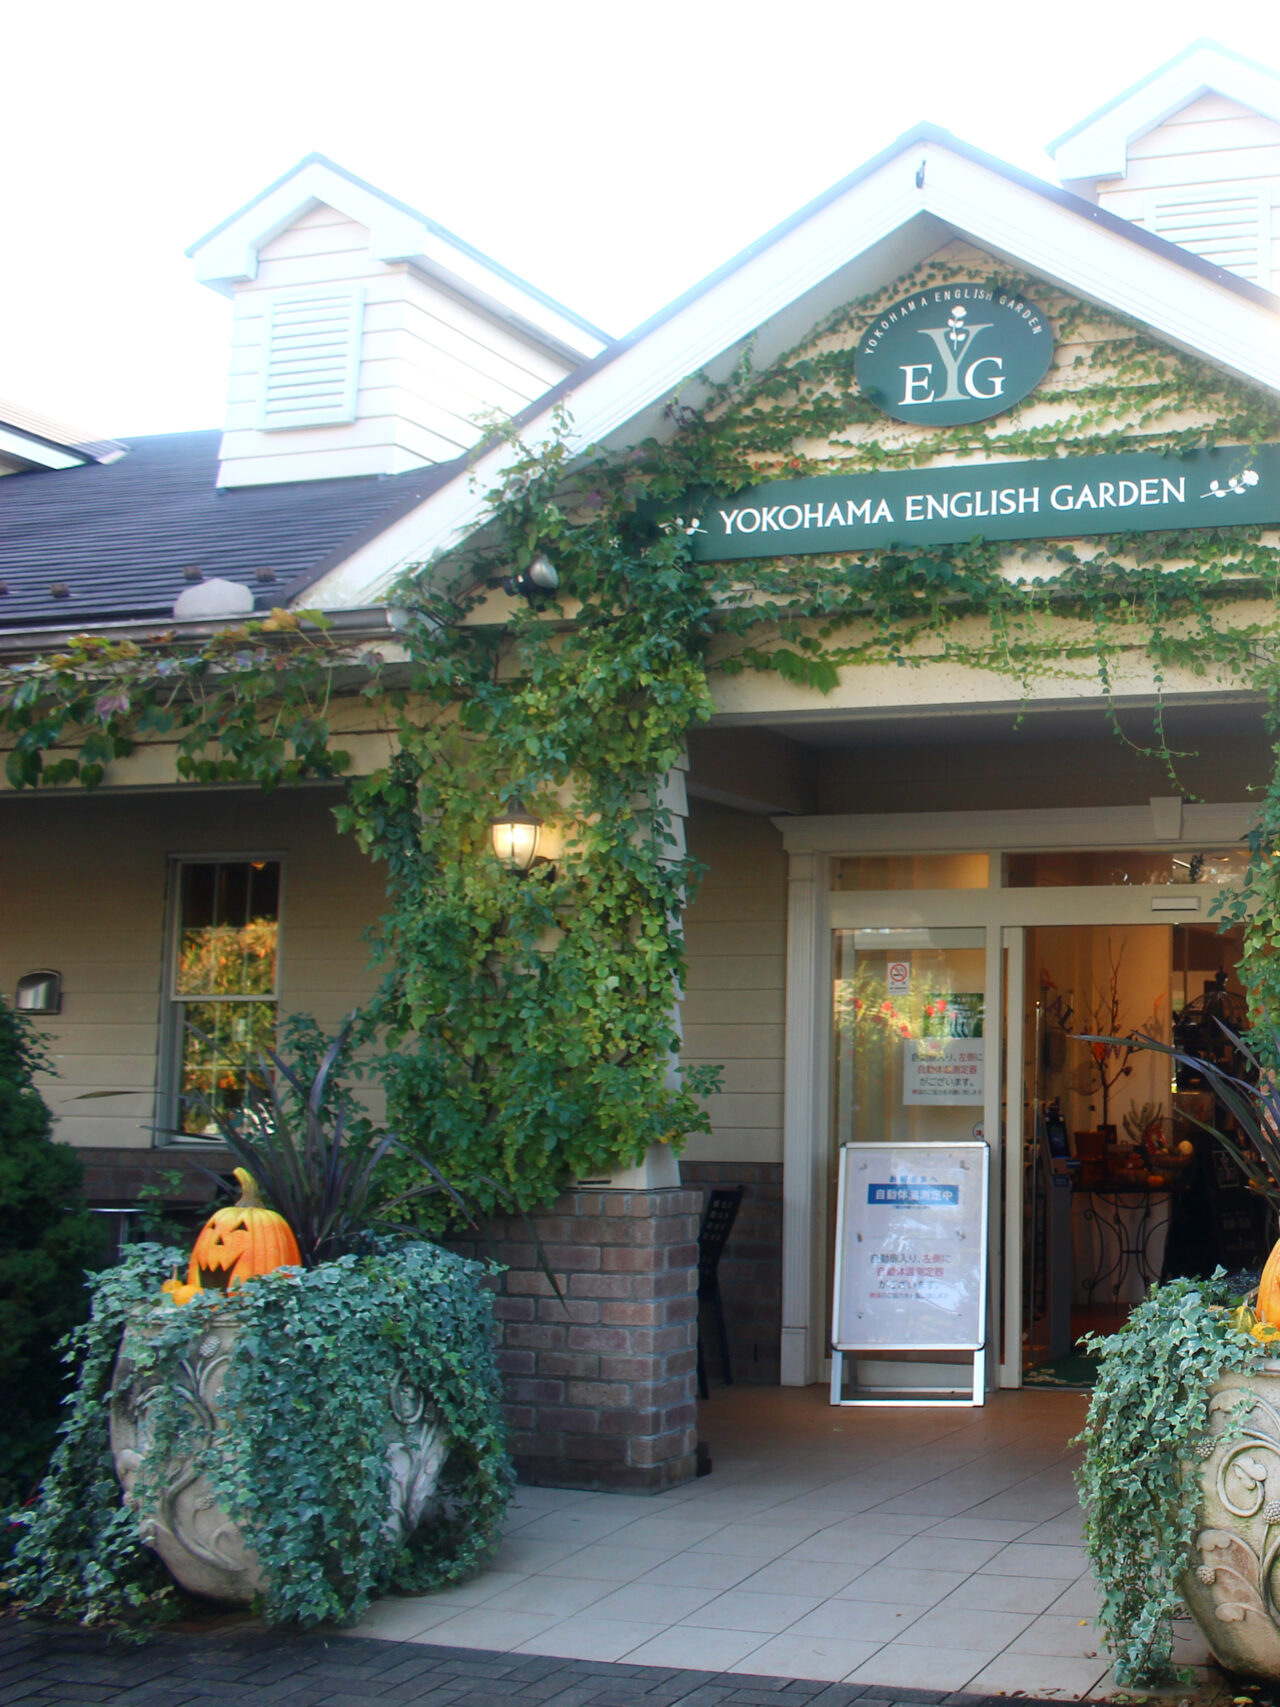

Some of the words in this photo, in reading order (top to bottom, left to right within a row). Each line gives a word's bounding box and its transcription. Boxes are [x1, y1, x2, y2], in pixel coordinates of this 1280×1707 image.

[864, 297, 928, 356] YOKOHAMA
[934, 288, 993, 302] ENGLISH
[999, 295, 1043, 335] GARDEN
[898, 323, 1005, 406] EYG
[719, 498, 894, 535] YOKOHAMA
[905, 486, 1040, 522] ENGLISH
[1049, 476, 1186, 512] GARDEN
